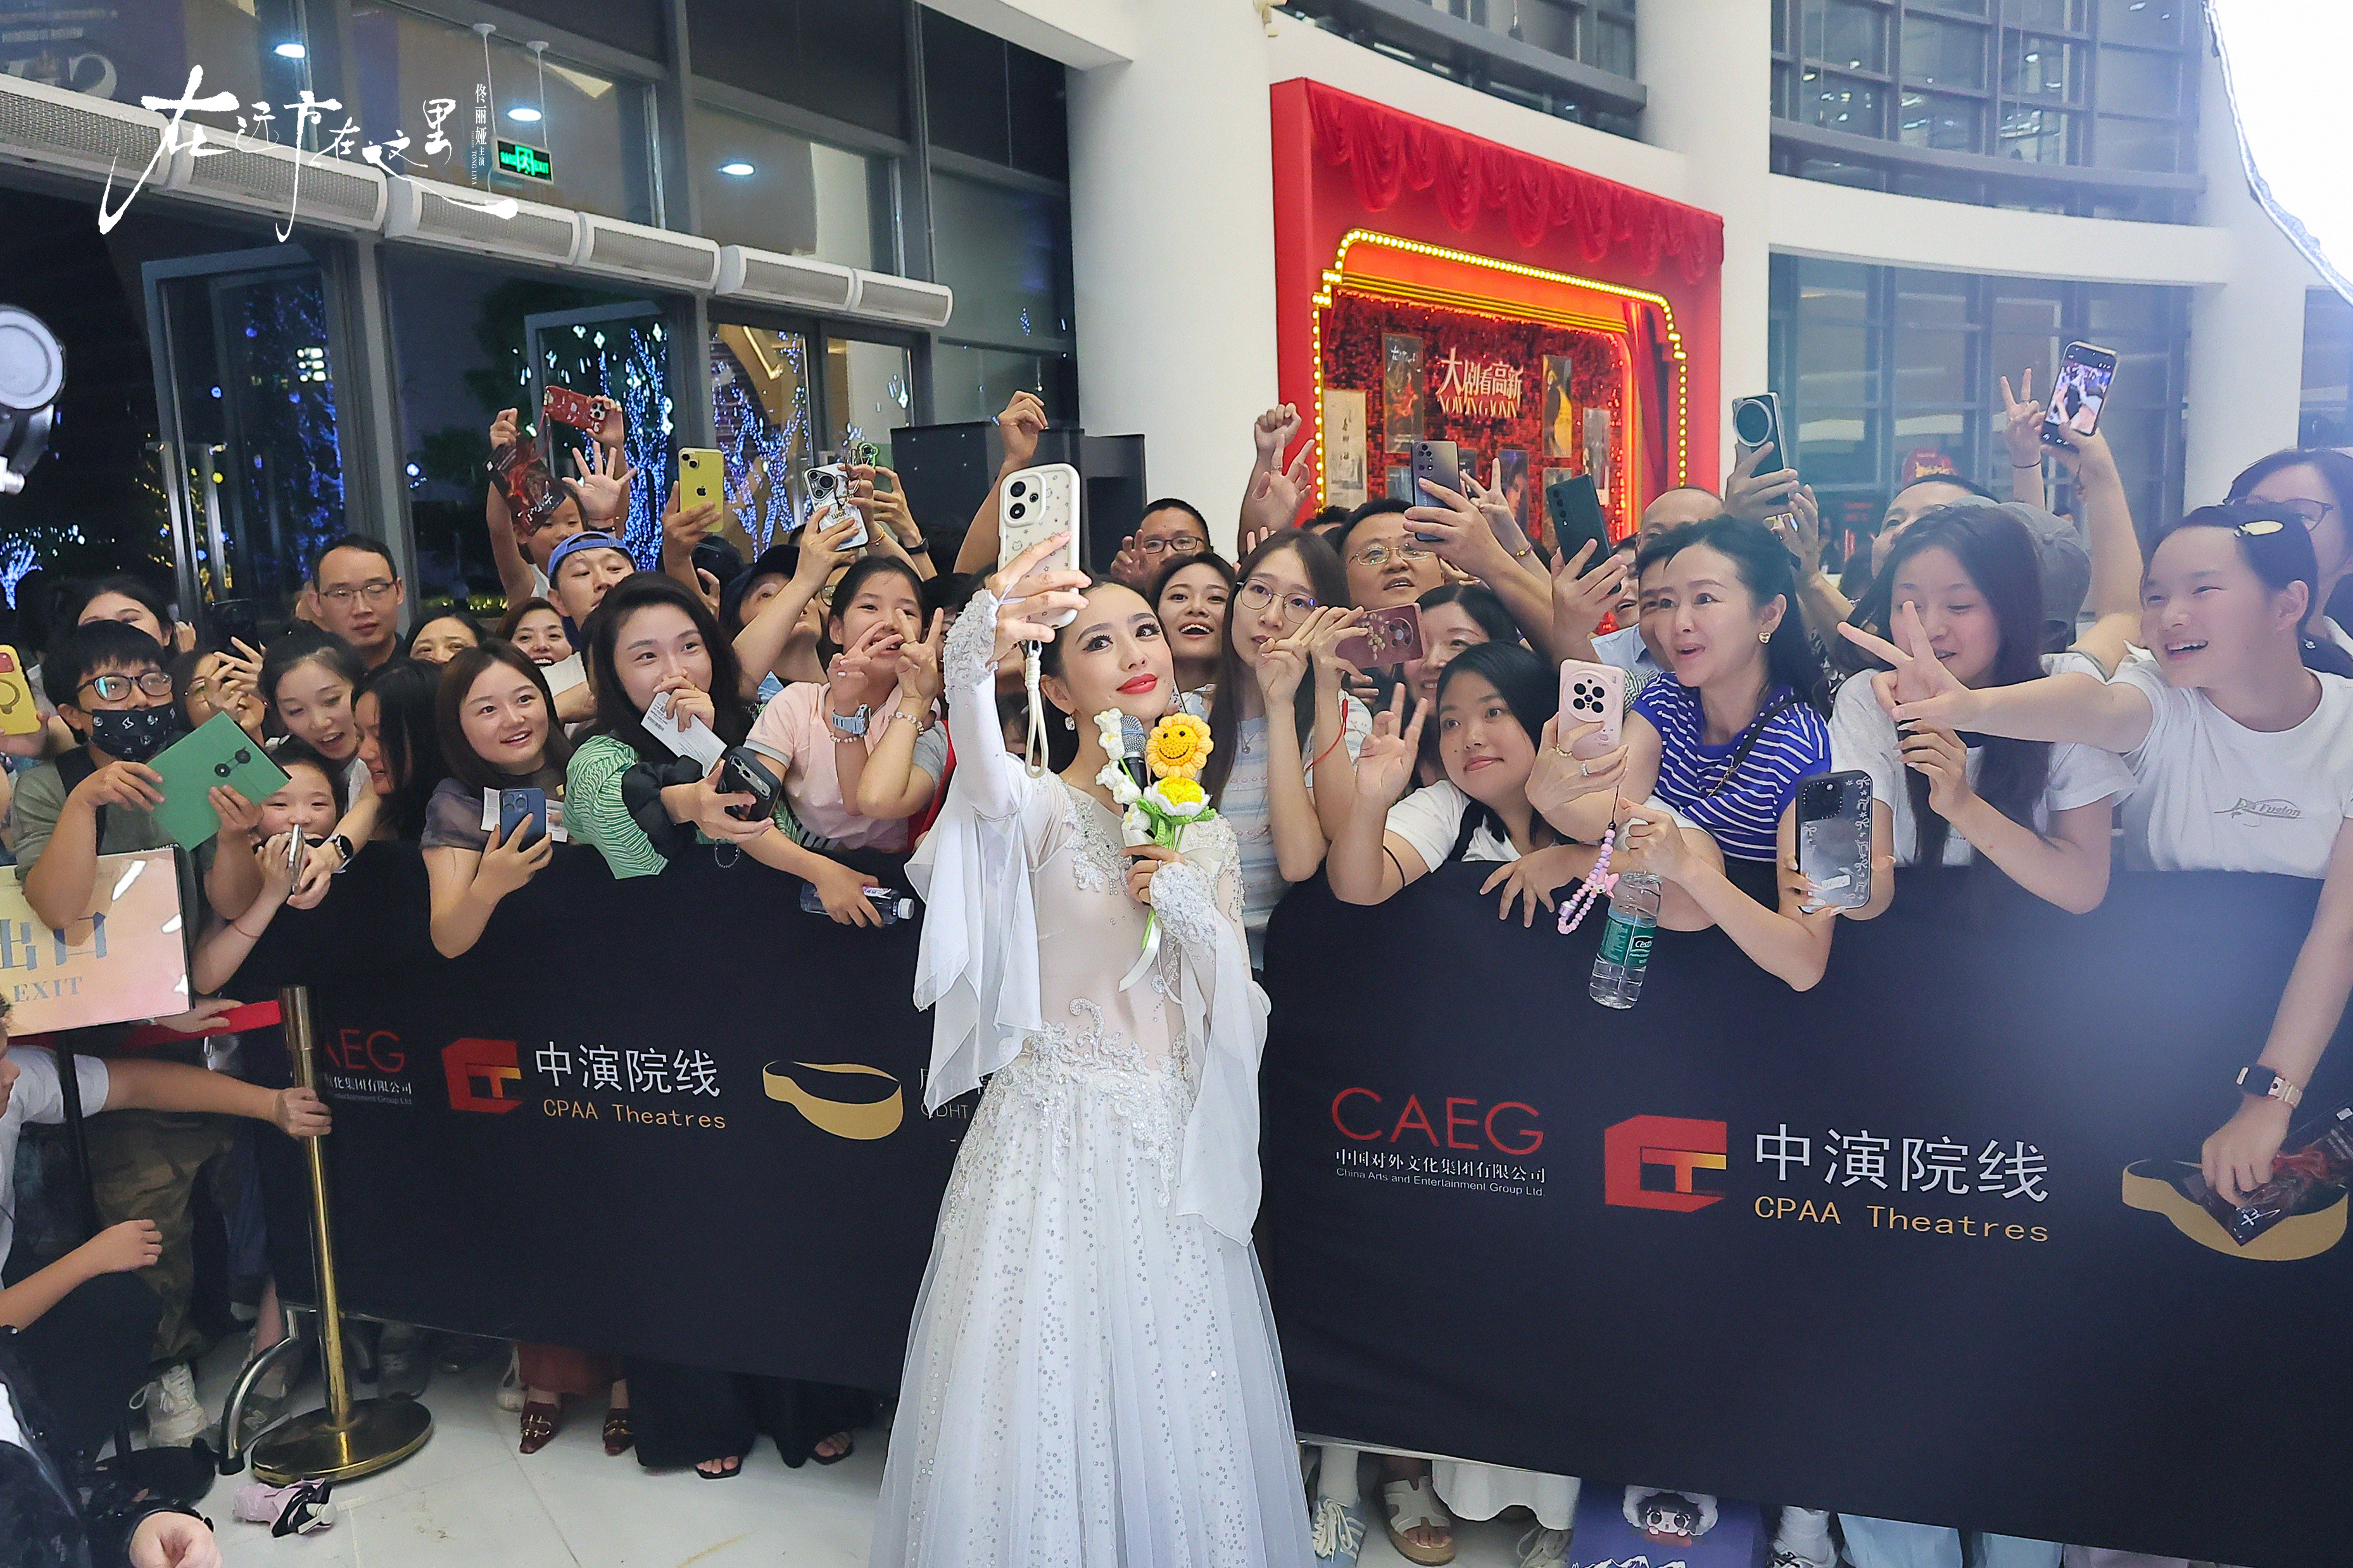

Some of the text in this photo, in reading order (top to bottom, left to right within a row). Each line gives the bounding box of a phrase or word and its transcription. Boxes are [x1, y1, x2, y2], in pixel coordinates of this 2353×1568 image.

[14, 976, 83, 1002] EXIT
[536, 1041, 721, 1098] 中演院线
[543, 1098, 726, 1130] CPAA Theatres
[1332, 1087, 1544, 1155] CAEG
[1336, 1148, 1546, 1184] 中国对外文化集团有限公司
[1336, 1168, 1546, 1196] China Arts and Entertainment Group Ltd.
[1755, 1124, 2049, 1202] 中演院线
[1754, 1195, 2049, 1243] CPAA Theatres
